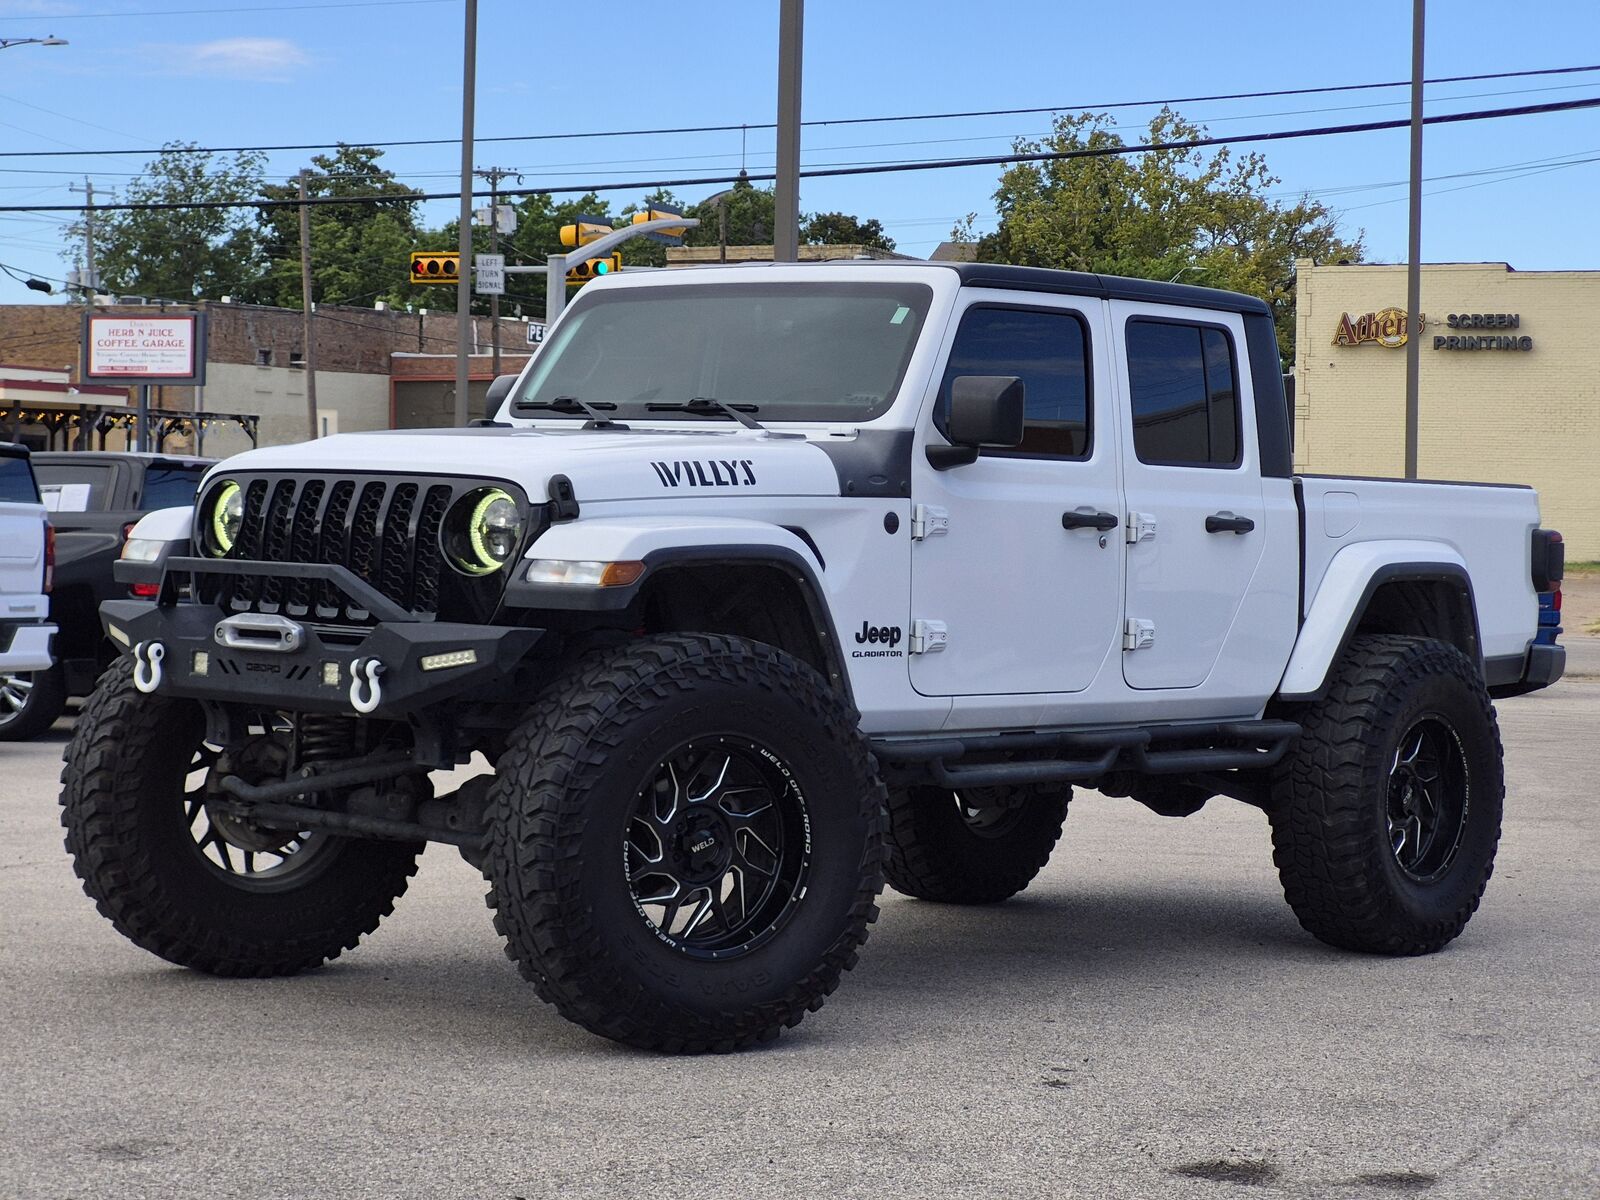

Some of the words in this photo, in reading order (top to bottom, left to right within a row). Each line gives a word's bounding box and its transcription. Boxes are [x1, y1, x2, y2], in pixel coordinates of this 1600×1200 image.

[481, 258, 498, 267] LEFT
[481, 269, 499, 278] TURN
[478, 281, 502, 289] SIGNAL
[1447, 313, 1520, 329] SCREEN
[108, 329, 135, 337] HERB
[138, 328, 145, 337] N
[148, 329, 174, 337] JUICE
[97, 339, 139, 348] COFFEE
[142, 339, 185, 348] GARAGE
[1433, 335, 1533, 351] PRINTING
[650, 459, 757, 488] WILLYS
[855, 620, 902, 648] Jeep
[851, 650, 903, 658] GLADIATOR
[760, 748, 791, 777] WELD
[789, 779, 811, 854] OFF-ROAD
[691, 837, 715, 853] WELD
[645, 919, 677, 948] WELD
